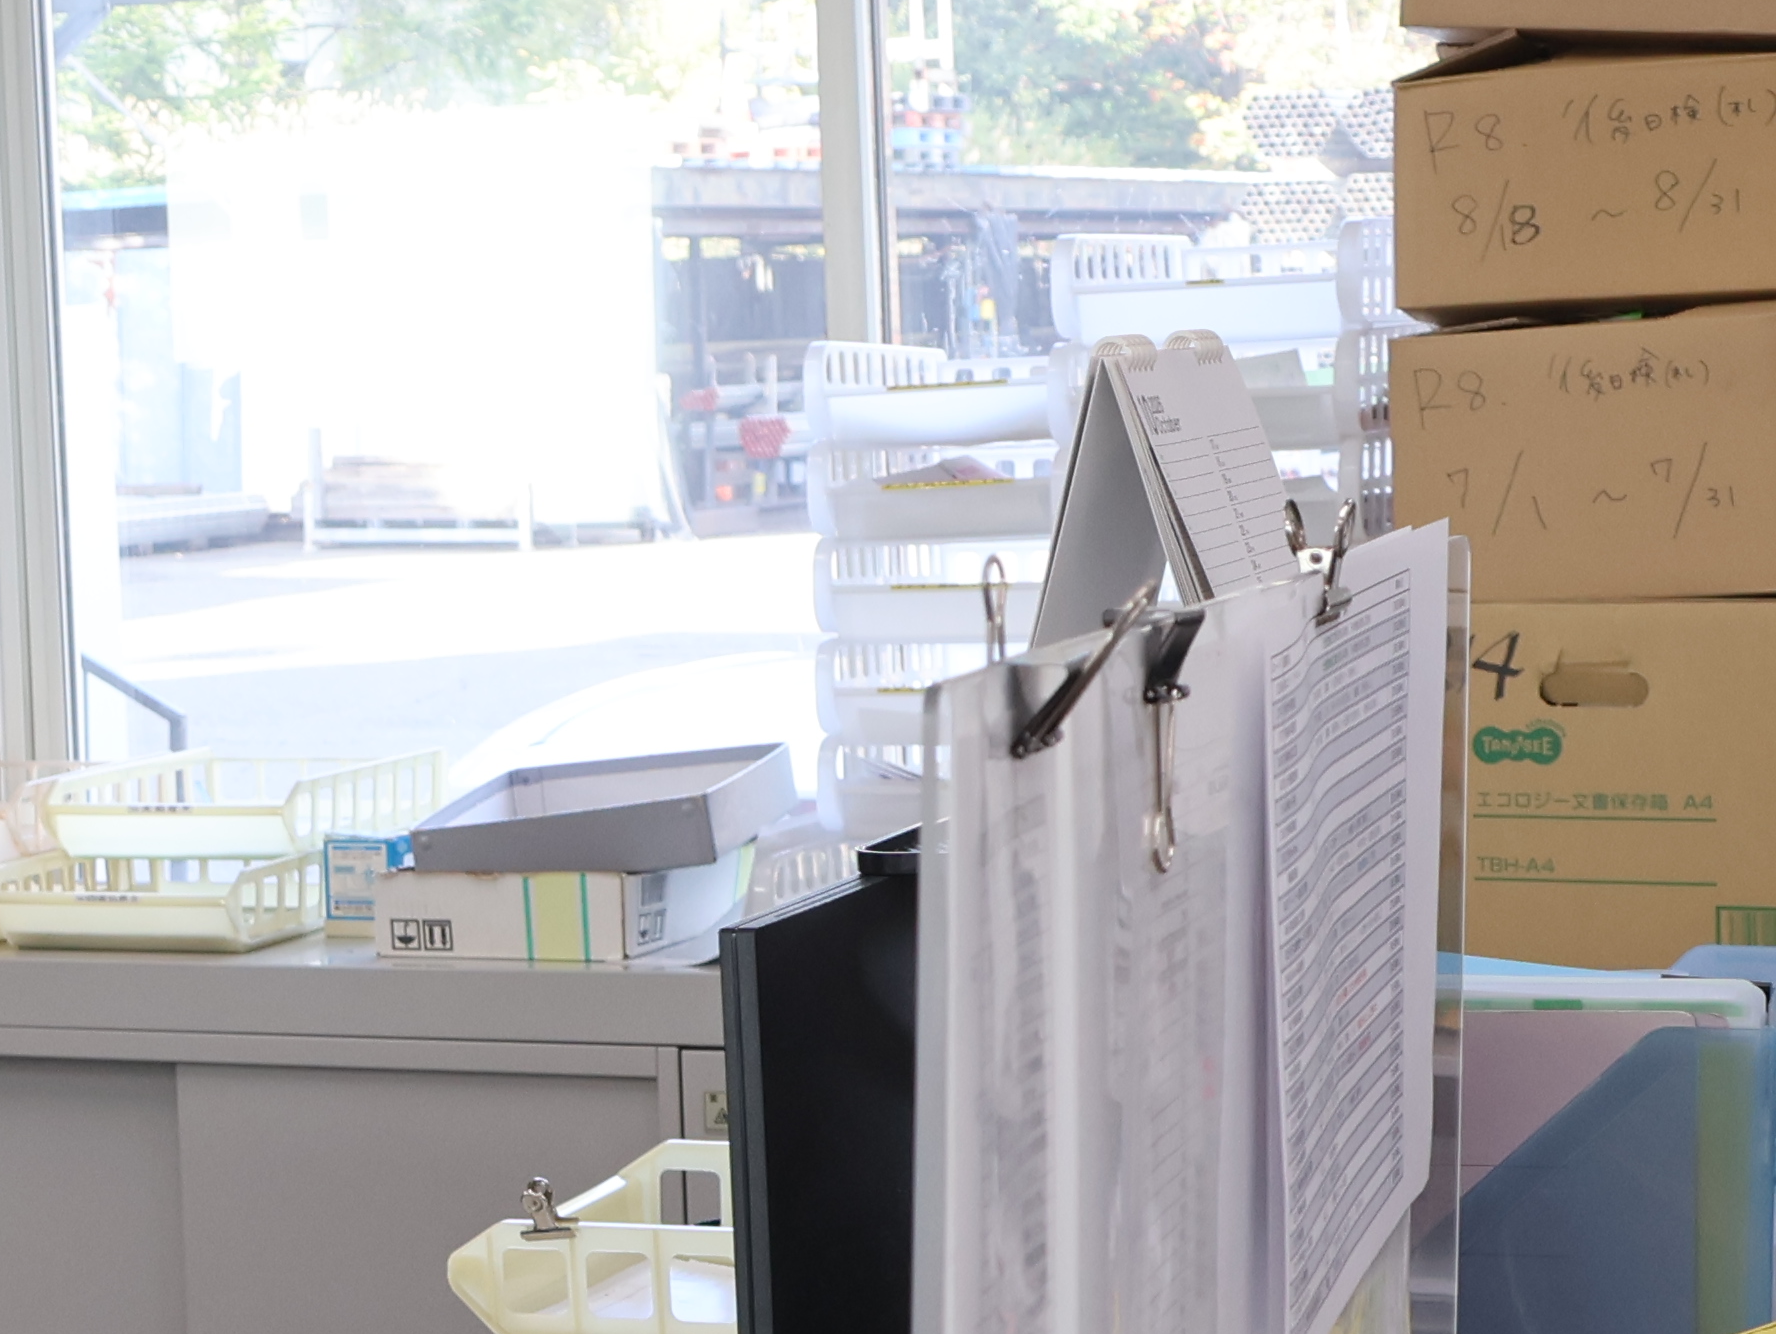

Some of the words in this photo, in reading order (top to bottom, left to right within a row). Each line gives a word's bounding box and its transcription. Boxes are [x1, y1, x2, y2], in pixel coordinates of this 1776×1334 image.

[1654, 157, 1742, 234] 8/31
[1650, 442, 1736, 540] 7/31
[1683, 794, 1715, 812] A4
